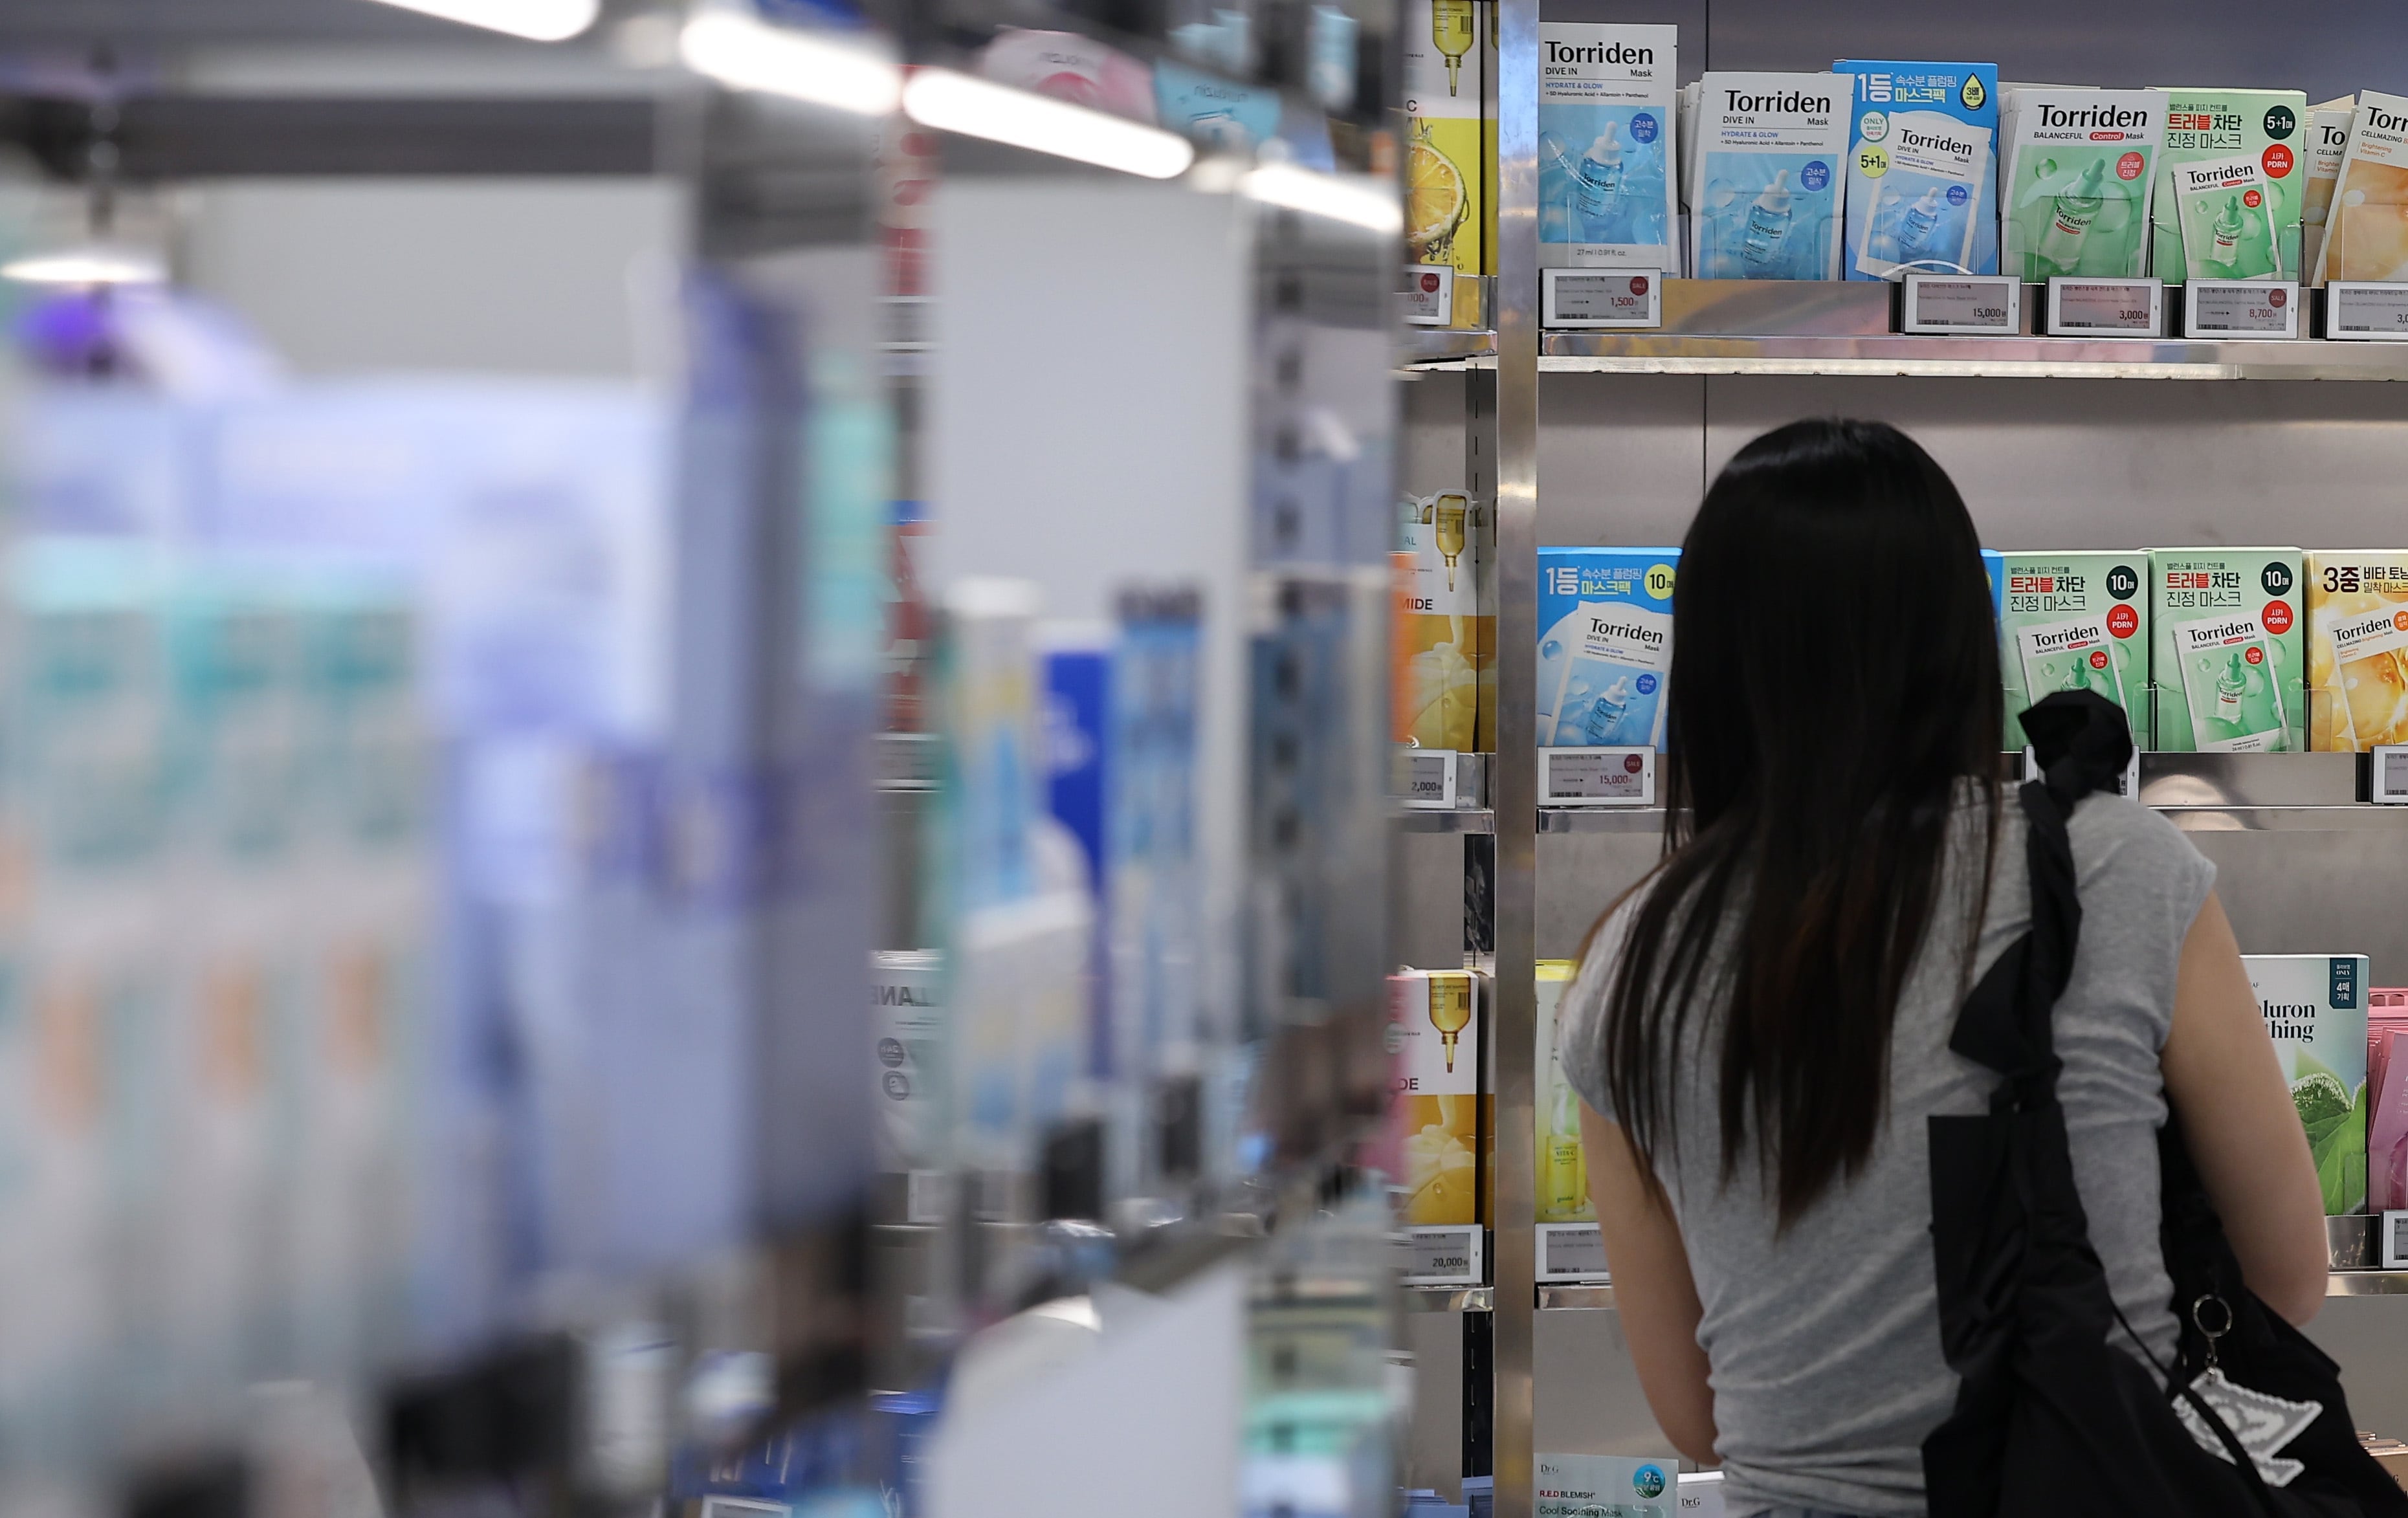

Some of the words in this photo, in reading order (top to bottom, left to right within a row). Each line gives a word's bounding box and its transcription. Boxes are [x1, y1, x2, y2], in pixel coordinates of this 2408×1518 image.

[1545, 41, 1653, 64] Torriden
[1857, 73, 1893, 103] 1등
[1895, 75, 1925, 87] 속수분
[1927, 75, 1957, 88] 플럼핑
[1895, 87, 1945, 103] 마스크팩
[1966, 87, 1980, 96] 3배
[1725, 90, 1830, 113] Torriden
[2038, 105, 2147, 127] Torriden
[2168, 113, 2211, 130] 트러블
[2213, 115, 2242, 130] 차단
[2267, 116, 2293, 129] 5+1매
[2367, 106, 2408, 132] Torr
[1635, 120, 1654, 129] 고수분
[1901, 129, 1972, 156] Torriden
[2168, 132, 2195, 149] 진정
[2201, 133, 2242, 149] 마스크
[2321, 126, 2346, 146] To
[2361, 130, 2403, 143] CELLMAZING
[2361, 142, 2392, 153] Brightening
[1861, 155, 1886, 169] 5+1매
[1583, 173, 1615, 188] Torriden
[2187, 164, 2254, 184] Torriden
[2056, 206, 2092, 226] Torriden
[1751, 220, 1782, 237] Torriden
[1546, 567, 1579, 595] 1등
[1582, 568, 1611, 580] 속수분
[1613, 568, 1642, 580] 플럼핑
[2167, 573, 2209, 589] 트러블
[2212, 572, 2240, 588] 차단
[2266, 571, 2289, 587] 10매
[2323, 567, 2360, 593] 3중
[2364, 566, 2386, 580] 비타
[1581, 580, 1631, 595] 마스크팩
[2010, 577, 2053, 593] 트러블
[2056, 577, 2086, 593] 차단
[2111, 575, 2135, 591] 10매
[2363, 582, 2382, 593] 밀착
[2383, 582, 2408, 593] 마스크
[2010, 596, 2039, 612] 진정
[2044, 595, 2086, 611] 마스크
[2167, 591, 2195, 608] 진정
[2200, 591, 2241, 607] 마스크
[1591, 617, 1663, 644] Torriden
[2112, 621, 2133, 629] PDRN
[2188, 622, 2254, 643] Torriden
[2333, 618, 2392, 642] Torriden
[2031, 626, 2099, 647] Torriden
[2336, 639, 2361, 649] CELLMAZING
[2035, 646, 2064, 654] BALANCEFUL
[2336, 982, 2350, 992] 4매
[2337, 993, 2350, 1001] 기획
[1682, 1497, 1700, 1506] Dr.G
[1540, 1506, 1558, 1515] Cool
